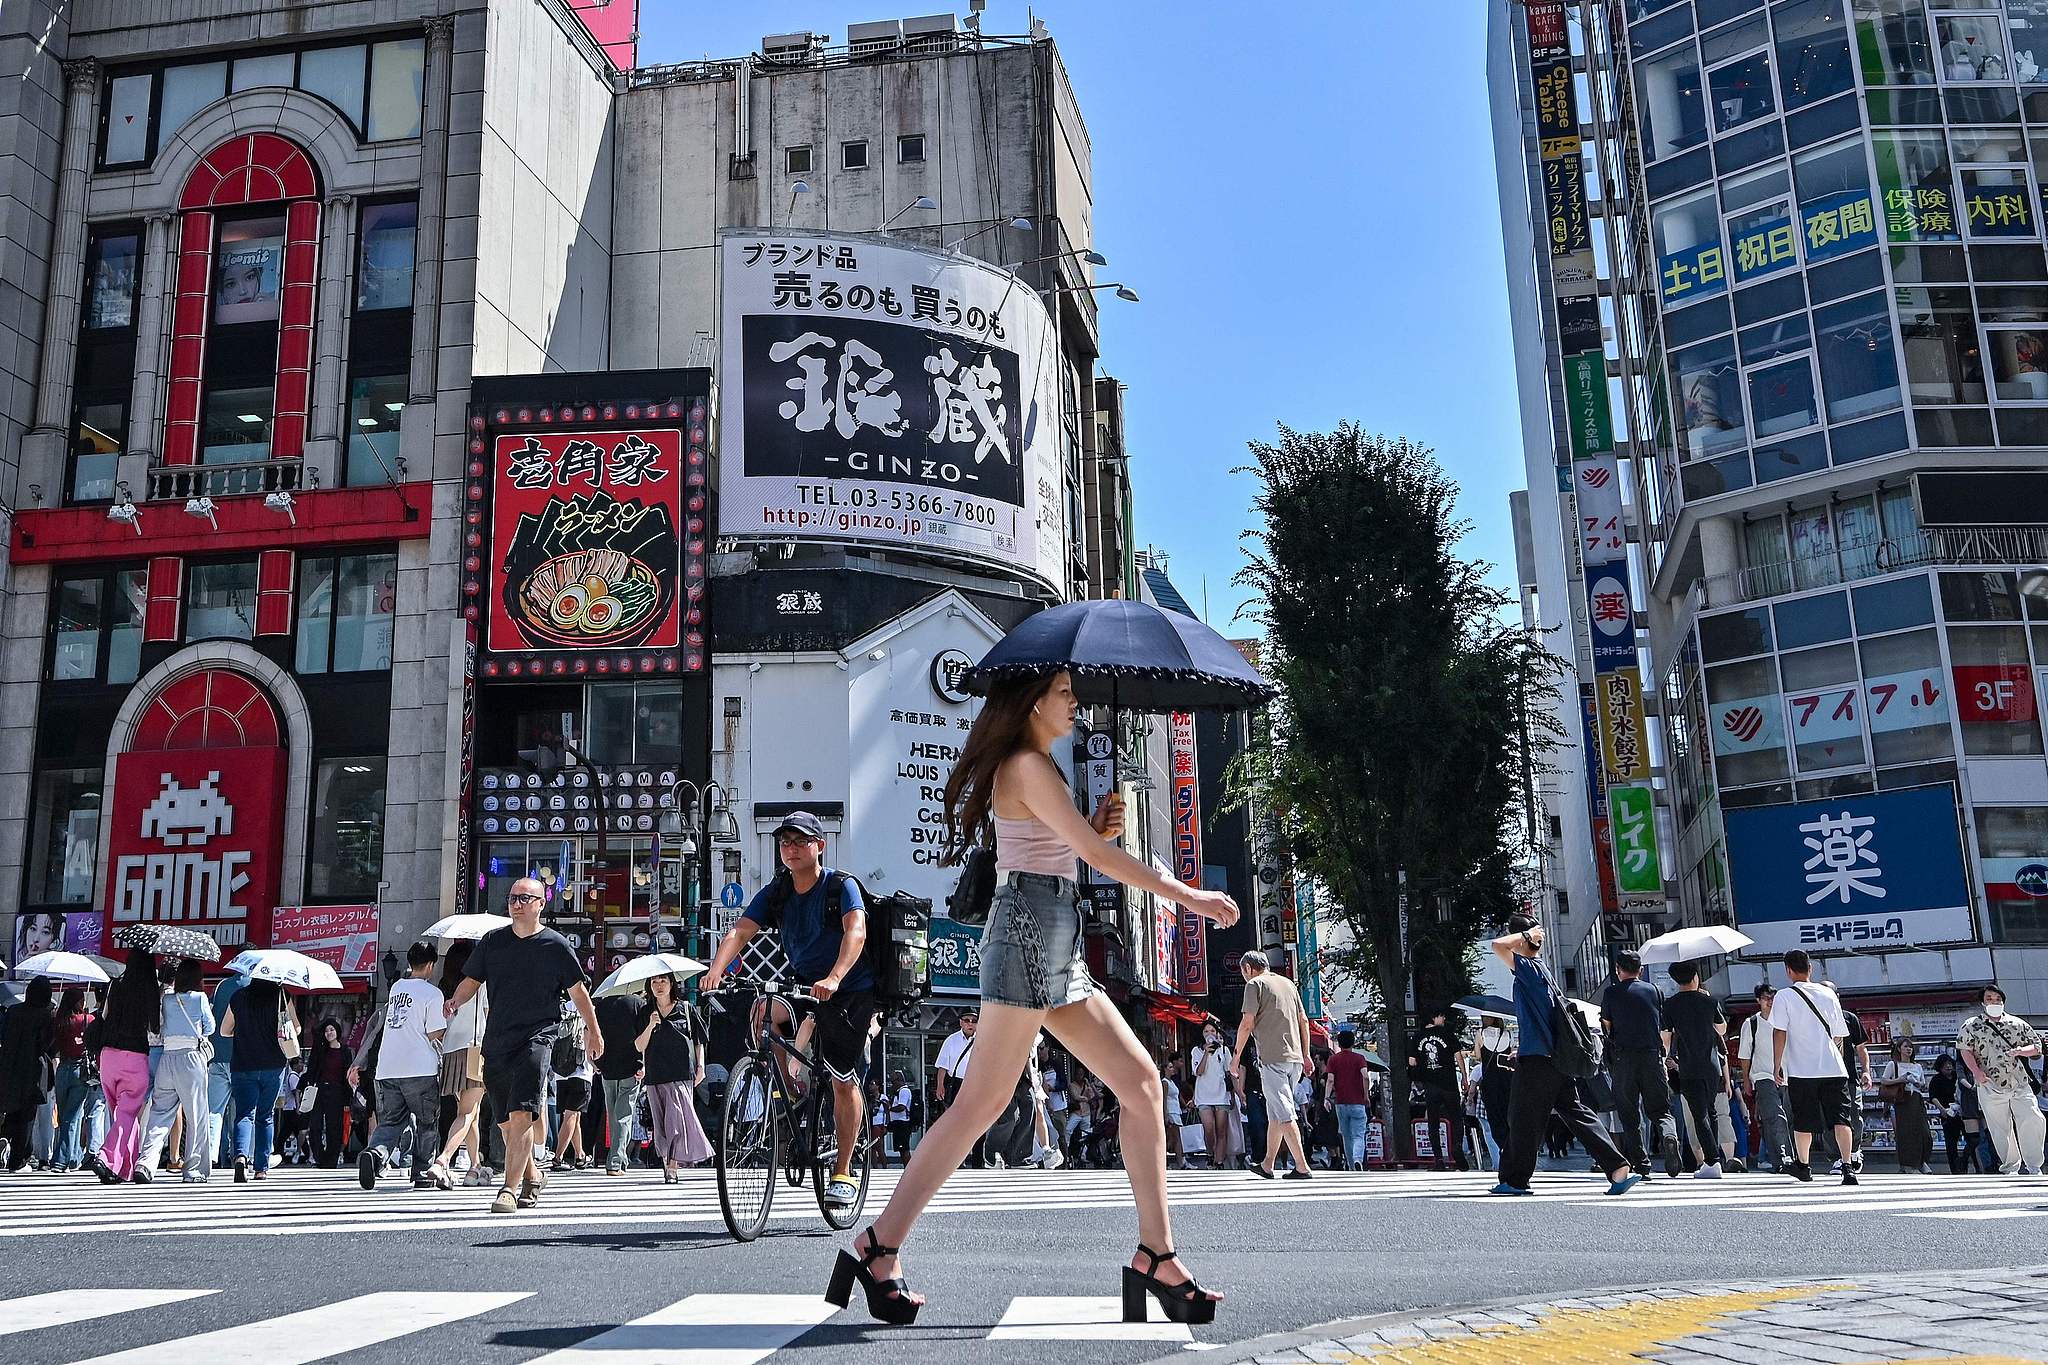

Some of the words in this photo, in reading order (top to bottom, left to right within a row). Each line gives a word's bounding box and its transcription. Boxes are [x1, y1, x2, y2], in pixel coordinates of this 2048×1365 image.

[1530, 4, 1562, 16] kawara
[1536, 15, 1557, 25] CAFE
[1532, 31, 1564, 44] DINING
[1533, 48, 1548, 58] 8F
[1538, 74, 1555, 123] Table
[1554, 66, 1568, 128] Cheese
[1542, 141, 1561, 152] 7F
[1548, 163, 1563, 217] クリニック
[1885, 189, 1948, 209] 保険
[1566, 169, 1585, 247] プライマリケア
[1966, 195, 2027, 226] 内科
[1888, 211, 1951, 231] 診療
[742, 243, 857, 270] ブランド品
[1553, 245, 1566, 254] 6F
[1664, 247, 1724, 297] 土・日
[1736, 225, 1796, 272] 祝日
[1806, 198, 1873, 248] 夜間
[773, 271, 903, 316] 売るのも
[911, 285, 1006, 340] 買うのも
[1563, 297, 1575, 305] 5F
[796, 485, 995, 525] TEL.03-5366-7800
[763, 508, 921, 534] http://ginzo.jp
[1594, 591, 1627, 622] 薬
[1792, 678, 1941, 728] アイフル
[1975, 680, 2014, 711] 3F
[890, 709, 947, 728] 高価買取
[1608, 676, 1641, 777] 肉汁水餃子
[1091, 737, 1108, 754] 質
[1173, 737, 1191, 746] Free
[1174, 729, 1190, 737] Tax
[897, 763, 939, 781] LOUIS
[1174, 750, 1193, 775] 薬
[529, 796, 625, 808] IEKI
[527, 817, 631, 830] RAMN
[1621, 801, 1648, 873] レイク
[1799, 811, 1887, 905] 薬
[113, 851, 250, 921] GAME
[1177, 784, 1203, 986] ダイコクラッグ
[1283, 920, 1297, 930] TY
[1283, 930, 1297, 940] EE
[1800, 918, 1904, 943] ミネドラッグ
